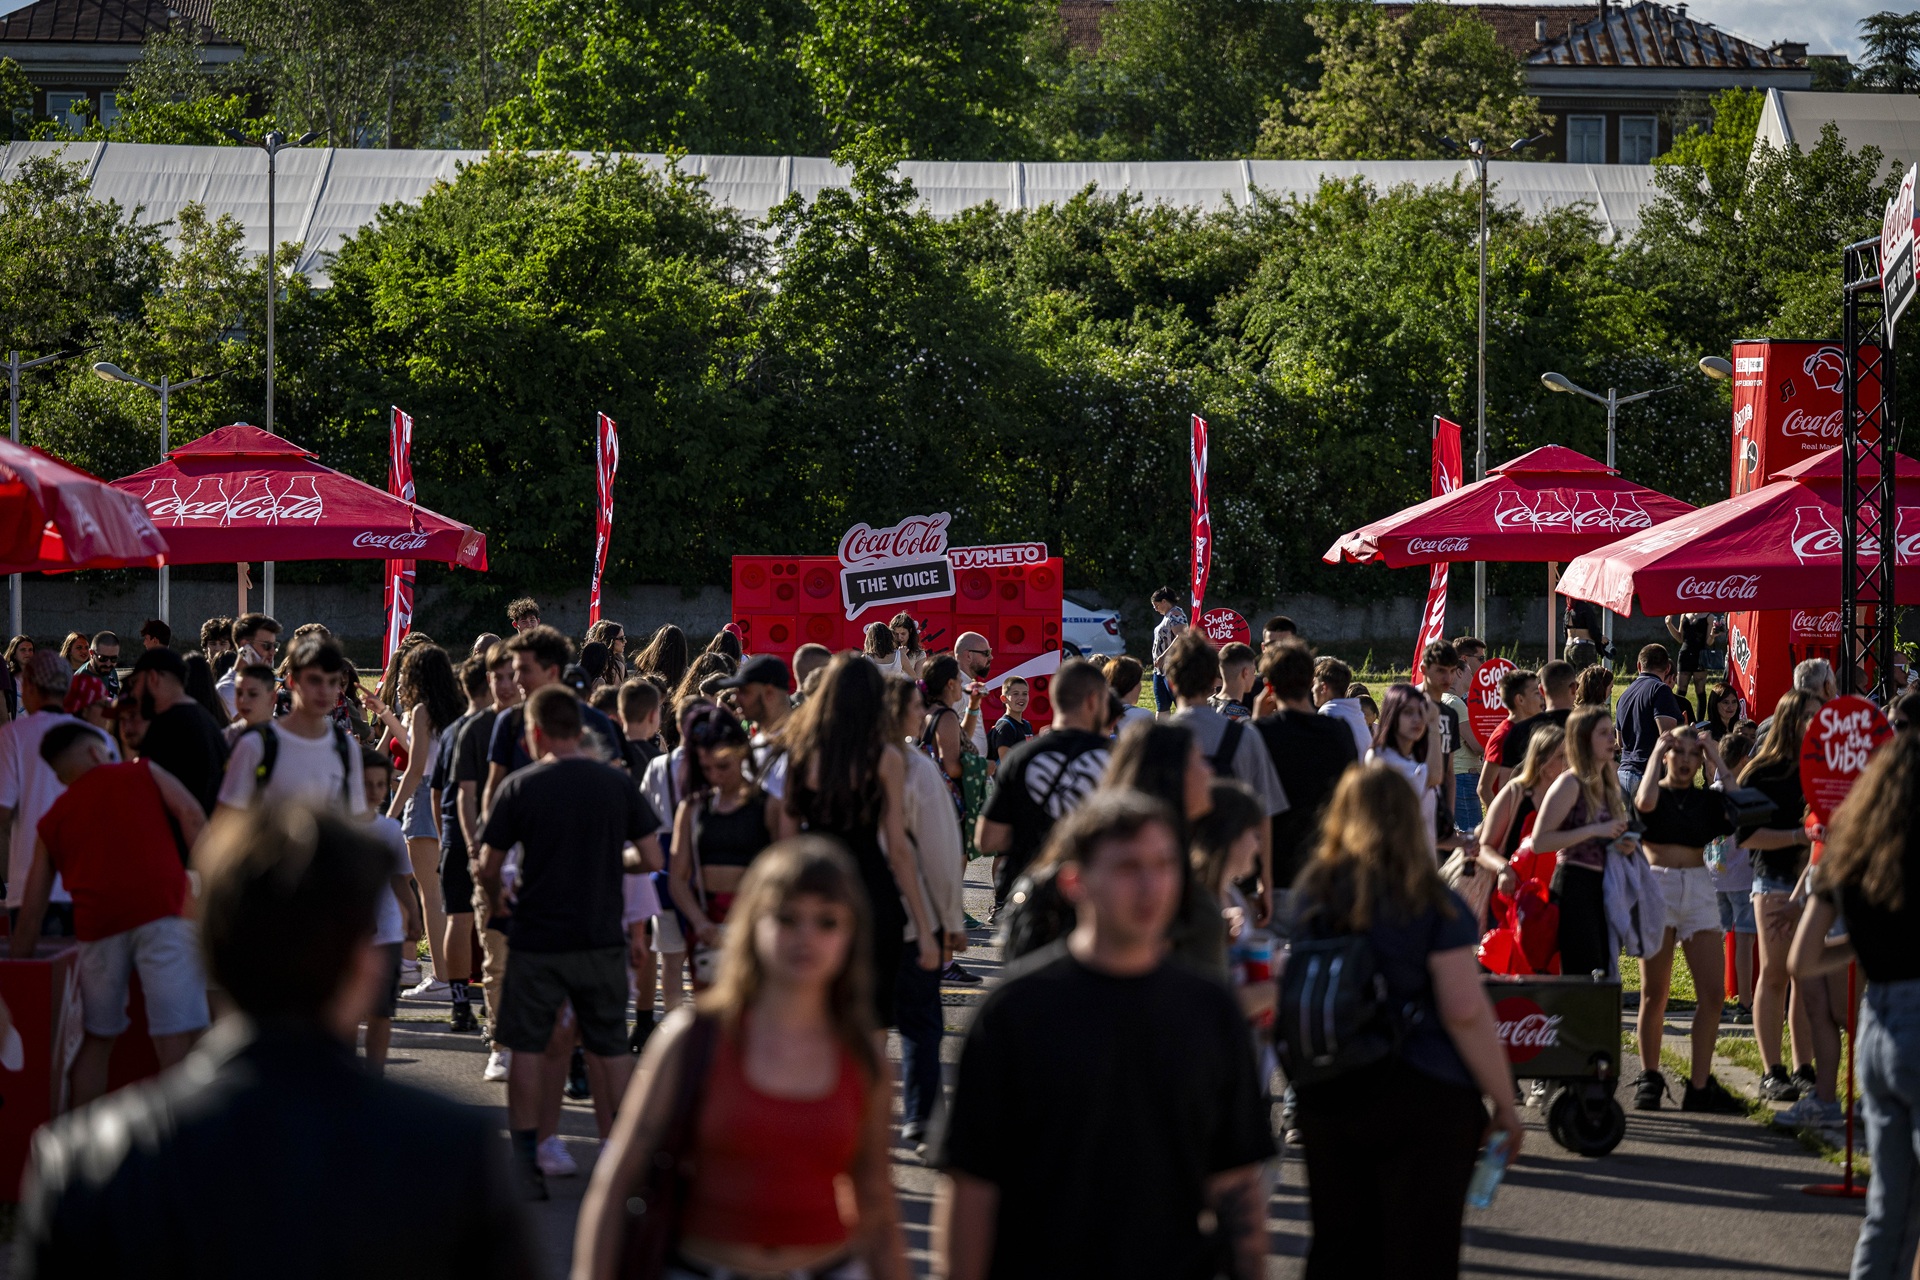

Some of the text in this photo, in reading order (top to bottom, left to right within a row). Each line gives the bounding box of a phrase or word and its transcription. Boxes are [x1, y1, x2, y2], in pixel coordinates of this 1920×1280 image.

[1883, 176, 1914, 261] Coca-Cola
[1887, 254, 1911, 305] THE VOICE
[1801, 442, 1818, 450] Real
[1496, 506, 1652, 528] Coca-Cola
[352, 531, 430, 550] Coca-Cola
[844, 518, 946, 563] Coca-Cola
[1407, 537, 1471, 555] Coca-Cola
[950, 546, 1040, 566] ТУРНЕТО
[857, 569, 940, 594] THE VOICE
[1676, 574, 1761, 600] Coca-Cola
[1204, 611, 1234, 627] Shake
[1219, 622, 1234, 630] the
[1207, 626, 1234, 640] Vibe
[1820, 707, 1872, 740] Share
[1847, 730, 1873, 749] the
[1824, 740, 1868, 774] Vibe
[1495, 1013, 1563, 1047] a-Cola
